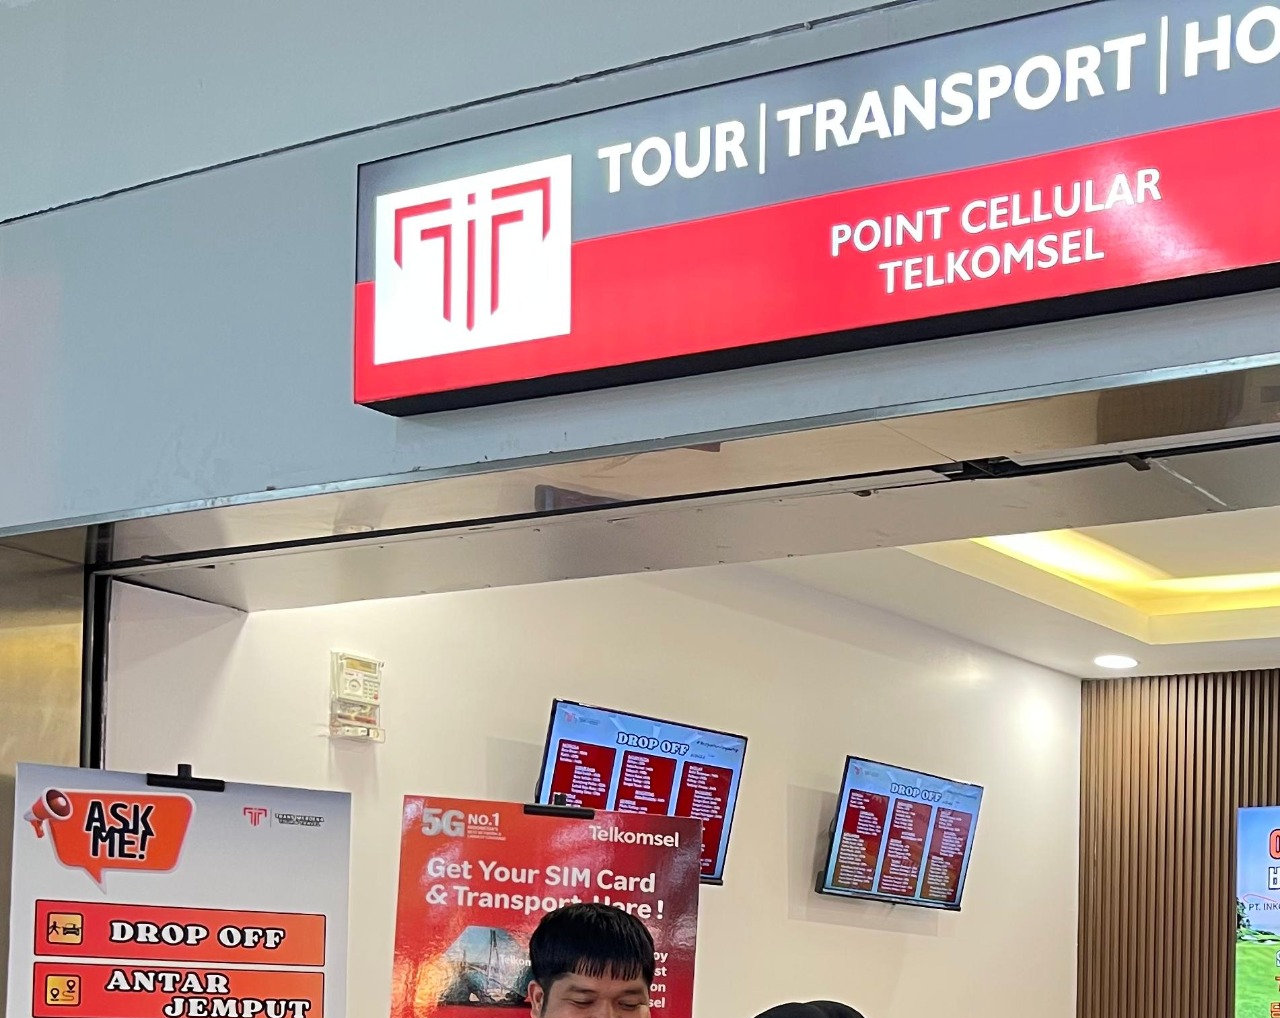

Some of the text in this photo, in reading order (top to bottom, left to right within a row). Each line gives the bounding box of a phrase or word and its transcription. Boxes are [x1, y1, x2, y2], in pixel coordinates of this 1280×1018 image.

[597, 119, 748, 194] TOUR
[776, 33, 1149, 158] TRANSPORT
[830, 168, 1162, 258] POINT CELLULAR
[879, 226, 1105, 294] TELKOMSEL
[617, 732, 659, 750] DROP
[660, 740, 689, 756] OFF
[890, 783, 942, 803] DROP OFF
[85, 800, 154, 836] ASK
[422, 808, 465, 836] 5G
[468, 813, 499, 826] NO.1
[91, 825, 150, 860] ME!
[589, 825, 680, 848] Telkomsel
[427, 857, 656, 893] Get Your SIM Card
[426, 884, 448, 906] &
[1249, 903, 1260, 911] PT.
[110, 921, 286, 950] DROP OFF
[106, 969, 230, 994] ANTAR
